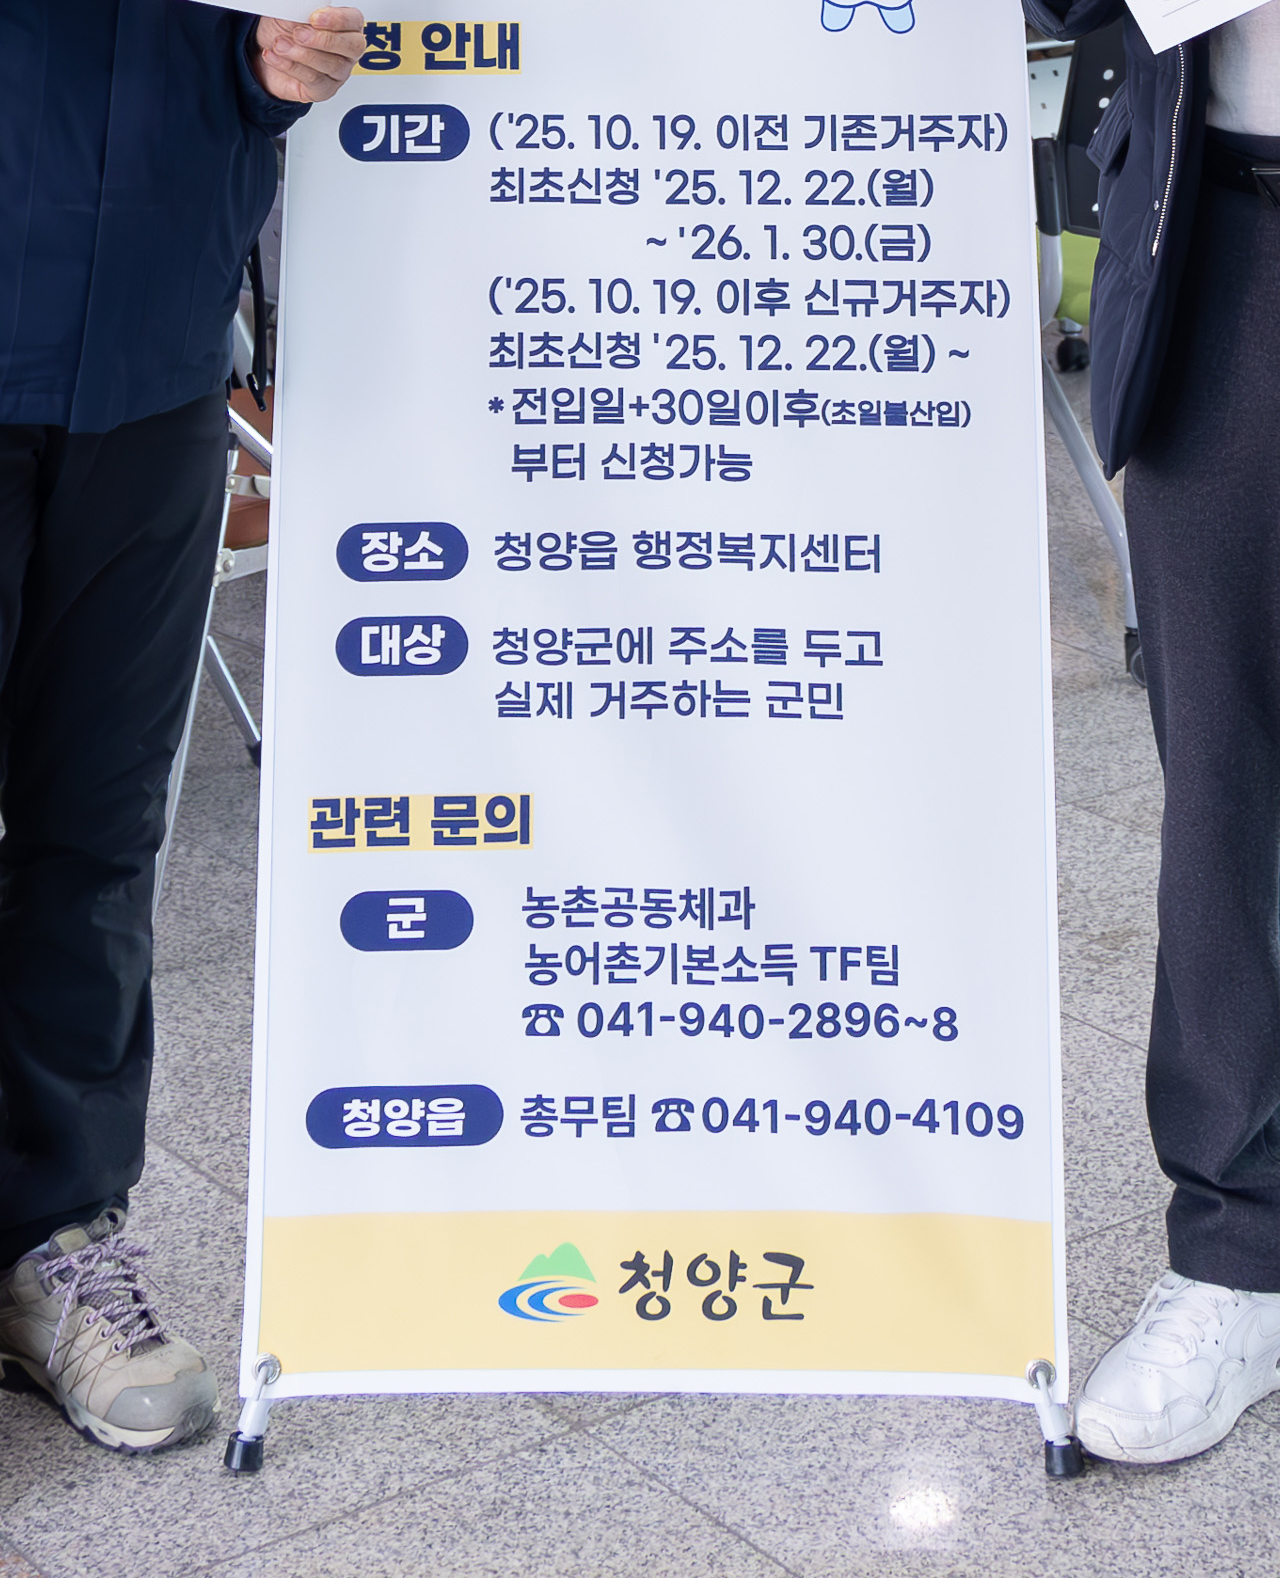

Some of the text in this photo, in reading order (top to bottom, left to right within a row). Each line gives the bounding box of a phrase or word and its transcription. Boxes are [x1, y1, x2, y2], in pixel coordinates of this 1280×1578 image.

[358, 22, 519, 72] 청 안내
[363, 112, 1007, 153] 기간 ('25. 10. 19. 이전 기존거주자)
[490, 167, 933, 207] 최초신청 '25. 12. 22.(월)
[680, 224, 750, 260] '26.
[764, 225, 789, 260] 1.
[803, 224, 931, 262] 30.(금)
[489, 276, 1010, 318] ('25. 10. 19. 이후 신규거주자)
[490, 332, 640, 369] 최초신청
[654, 333, 725, 370] '25.
[740, 335, 792, 370] 12.
[806, 334, 935, 373] 22.(월)
[512, 443, 752, 482] 부터 신청가능
[362, 531, 880, 573] 장소 청양읍 행정복지센터
[362, 624, 883, 667] 대상 청양군에 주소를 두고
[496, 680, 843, 719] 실제 거주하는 군민
[311, 795, 530, 848] 관련 문의
[387, 886, 755, 938] 군 농촌공동체과
[525, 942, 898, 986] 농어촌기본소득 TF팀
[578, 1002, 958, 1041] 041-940-2896~8
[343, 1094, 1023, 1139] 청양읍 총무팀 041-940-4109
[619, 1250, 814, 1321] 청양군
